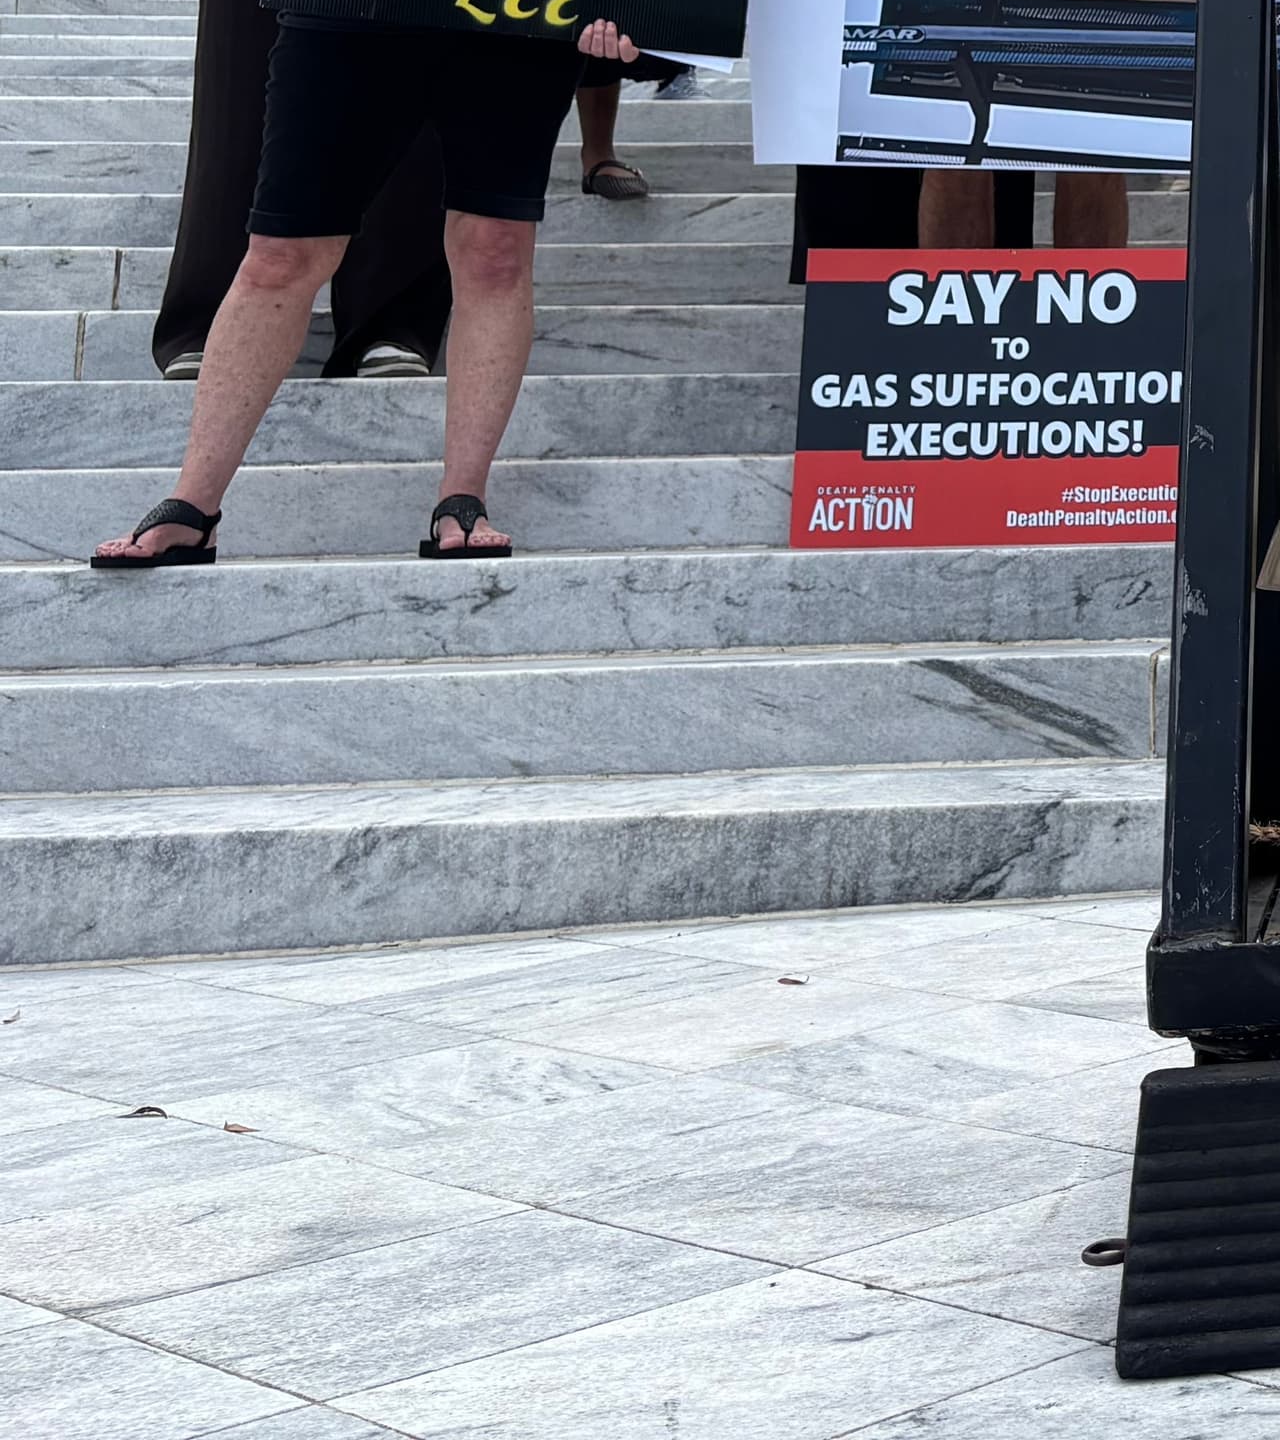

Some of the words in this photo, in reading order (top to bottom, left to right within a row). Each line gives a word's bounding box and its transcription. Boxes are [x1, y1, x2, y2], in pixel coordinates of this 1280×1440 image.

[888, 273, 1017, 325] SAY
[1036, 271, 1137, 324] NO
[992, 337, 1030, 360] TO
[811, 374, 898, 408] GAS
[867, 420, 1144, 456] EXECUTIONS!
[817, 486, 857, 495] DEATH
[862, 485, 916, 494] PENALTY
[1062, 485, 1177, 503] #StopExecutio
[808, 495, 914, 531] ACTION
[1007, 508, 1176, 528] DeathPenaltyAction.
